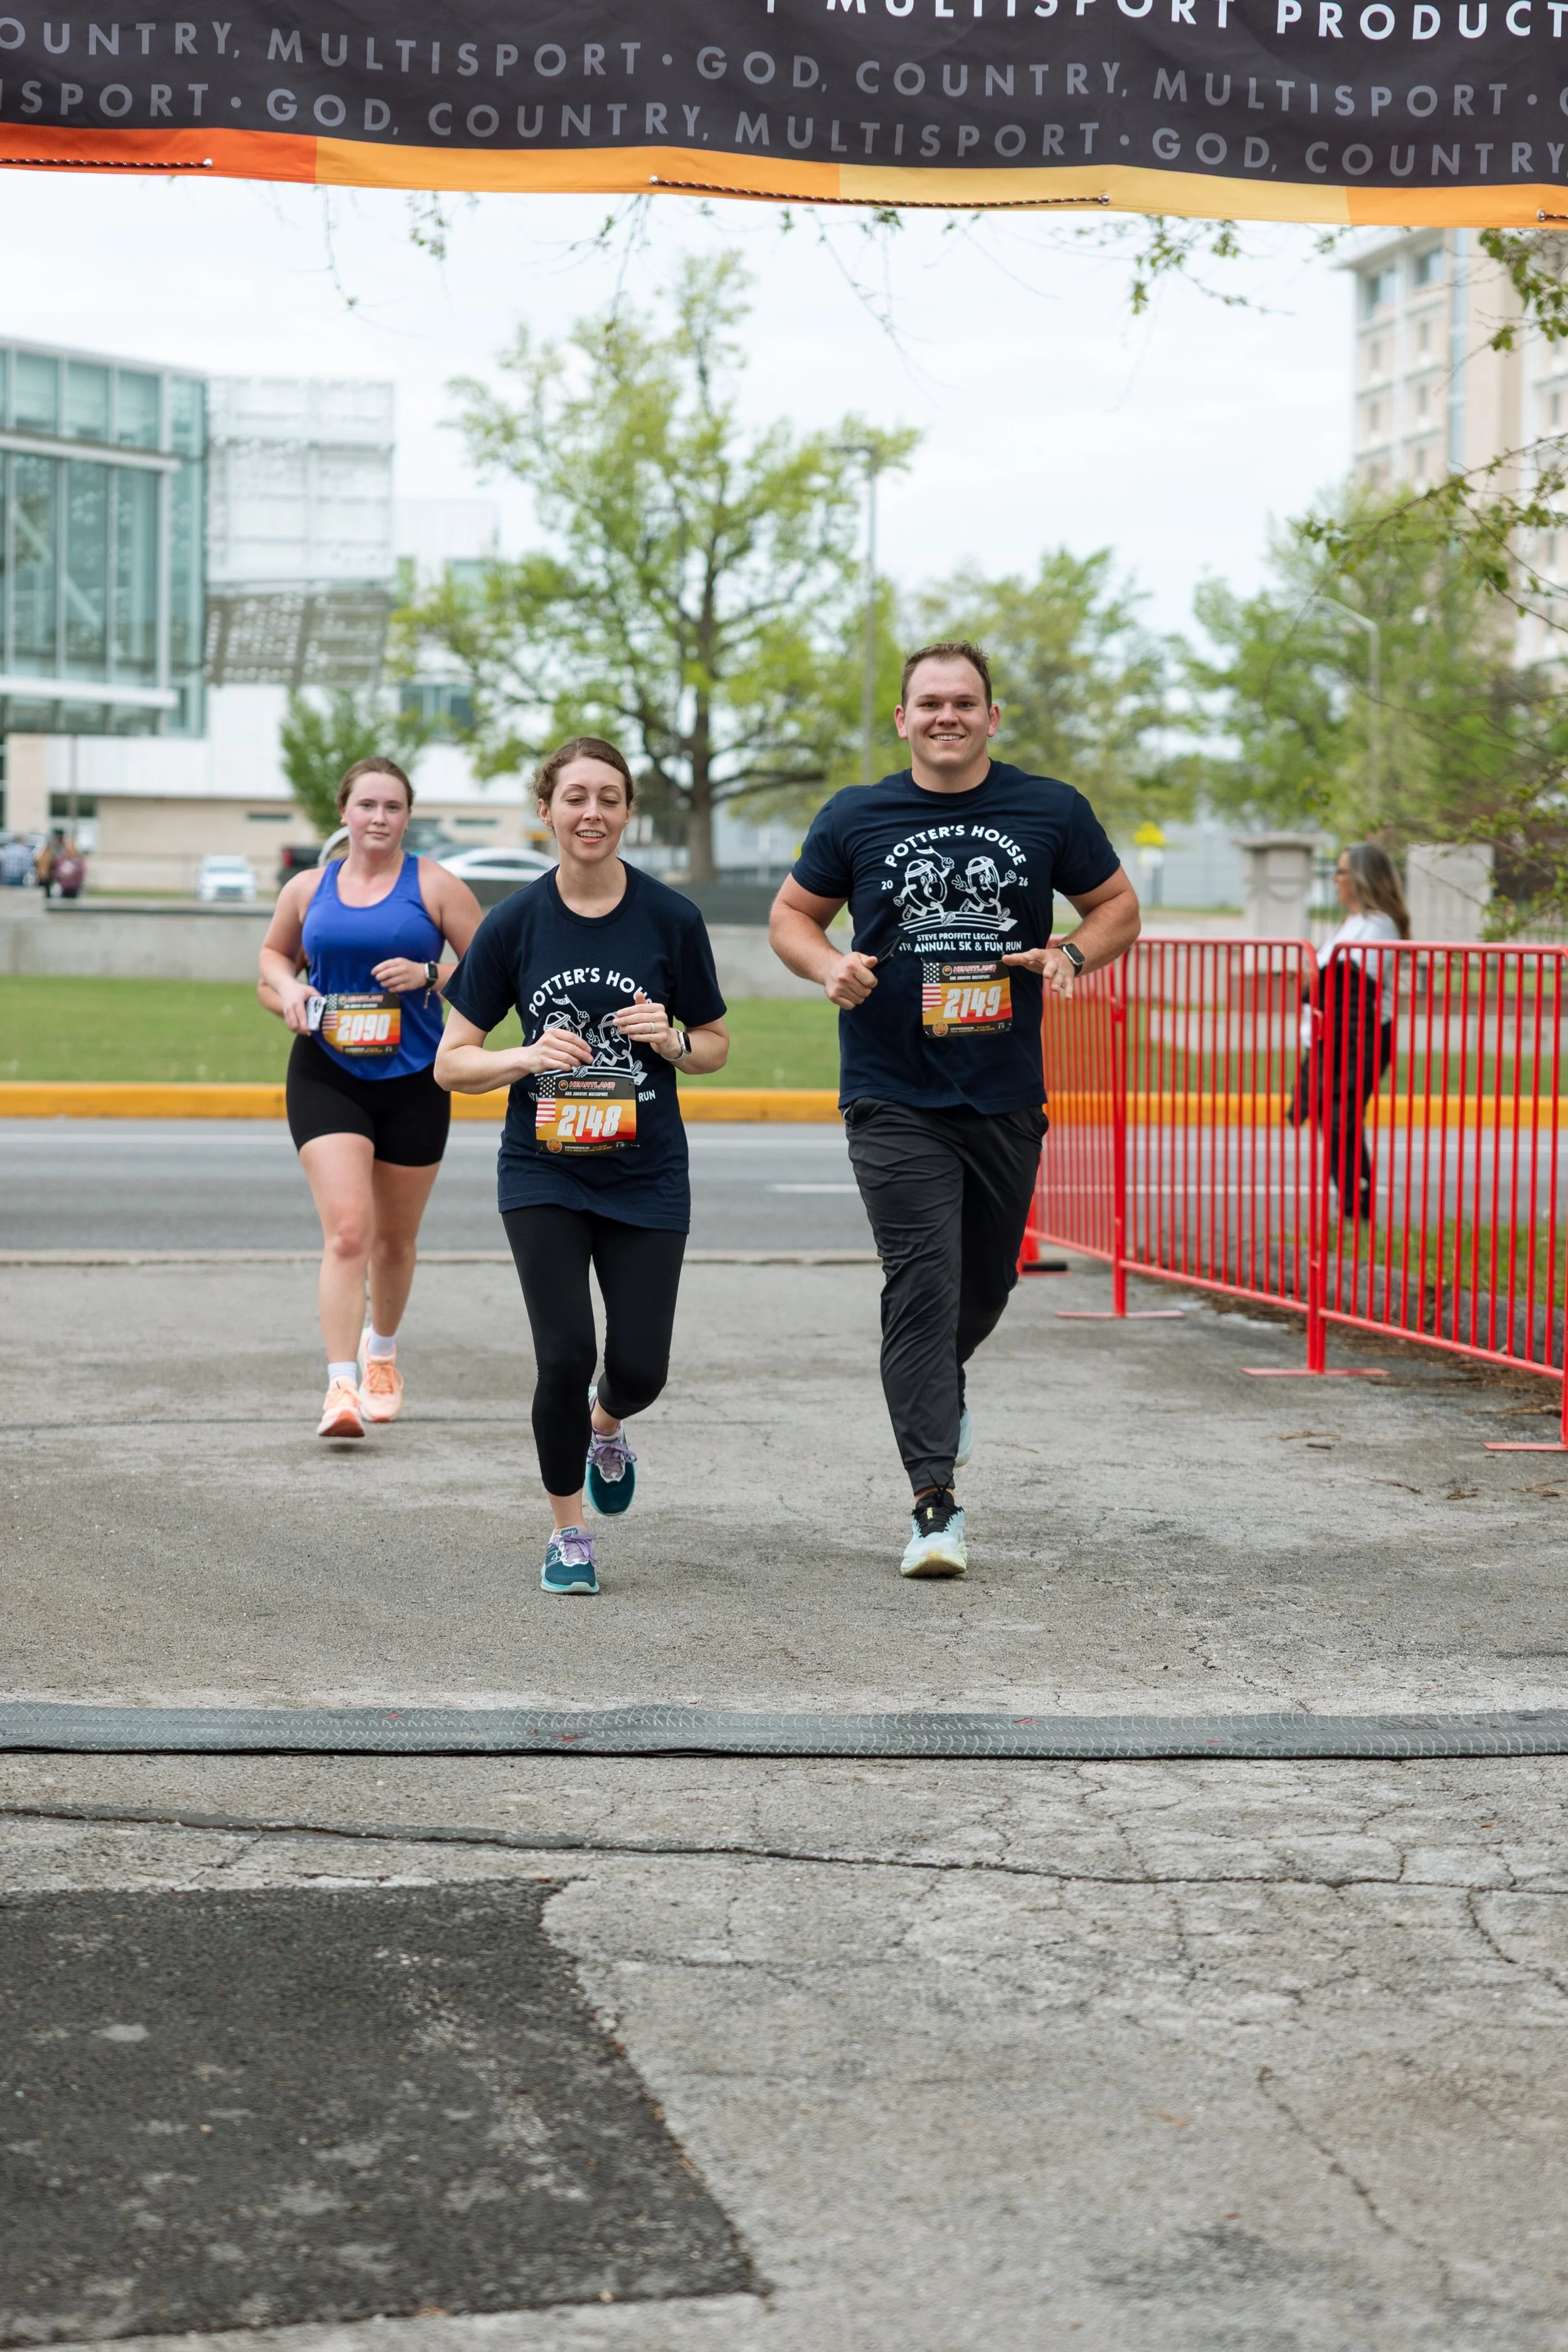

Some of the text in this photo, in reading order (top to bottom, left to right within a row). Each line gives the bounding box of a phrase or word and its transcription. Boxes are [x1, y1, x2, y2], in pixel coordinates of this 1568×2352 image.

[1276, 0, 1568, 40] PRODUCT
[268, 28, 642, 77] MULTISPORT
[697, 46, 828, 93] GOD,
[856, 61, 1128, 98] COUNTRY,
[1153, 67, 1508, 118] MULTISPORT
[267, 88, 399, 136] GOD,
[428, 102, 709, 141] COUNTRY,
[734, 112, 1099, 158] MULTISPORT
[1152, 127, 1277, 173] GOD,
[1305, 141, 1568, 177] COUNTRY
[884, 825, 1027, 867] POTTER'S HOUSE
[881, 876, 1028, 890] 20 26
[914, 941, 956, 953] ANNUAL
[959, 941, 972, 951] 5K
[975, 942, 982, 951] &
[985, 942, 1003, 952] FUN
[1005, 941, 1022, 951] RUN
[939, 932, 972, 940] PROFFITT
[529, 967, 652, 1017] POTTER'S HOU
[943, 985, 1002, 1019] 2149
[336, 1013, 391, 1042] 2090
[569, 1081, 616, 1089] HEARTLAND
[638, 1089, 656, 1102] RUN
[557, 1104, 622, 1137] 2148
